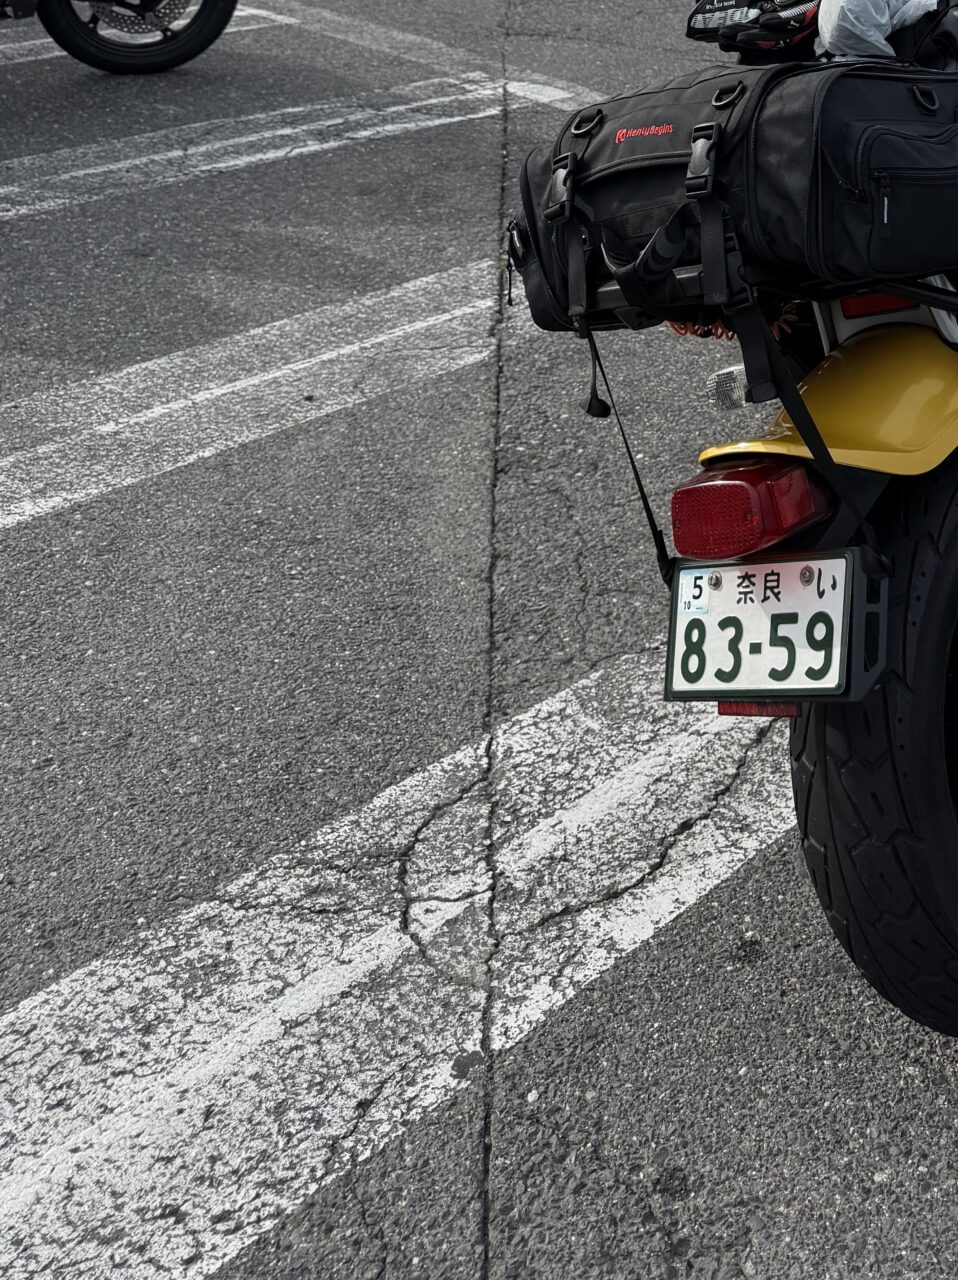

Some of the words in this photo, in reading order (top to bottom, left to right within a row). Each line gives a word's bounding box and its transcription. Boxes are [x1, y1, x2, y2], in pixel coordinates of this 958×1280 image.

[692, 576, 703, 600] 5
[736, 570, 781, 604] 奈良
[817, 568, 837, 599] い
[683, 601, 691, 610] 10
[681, 611, 834, 684] 83-59
